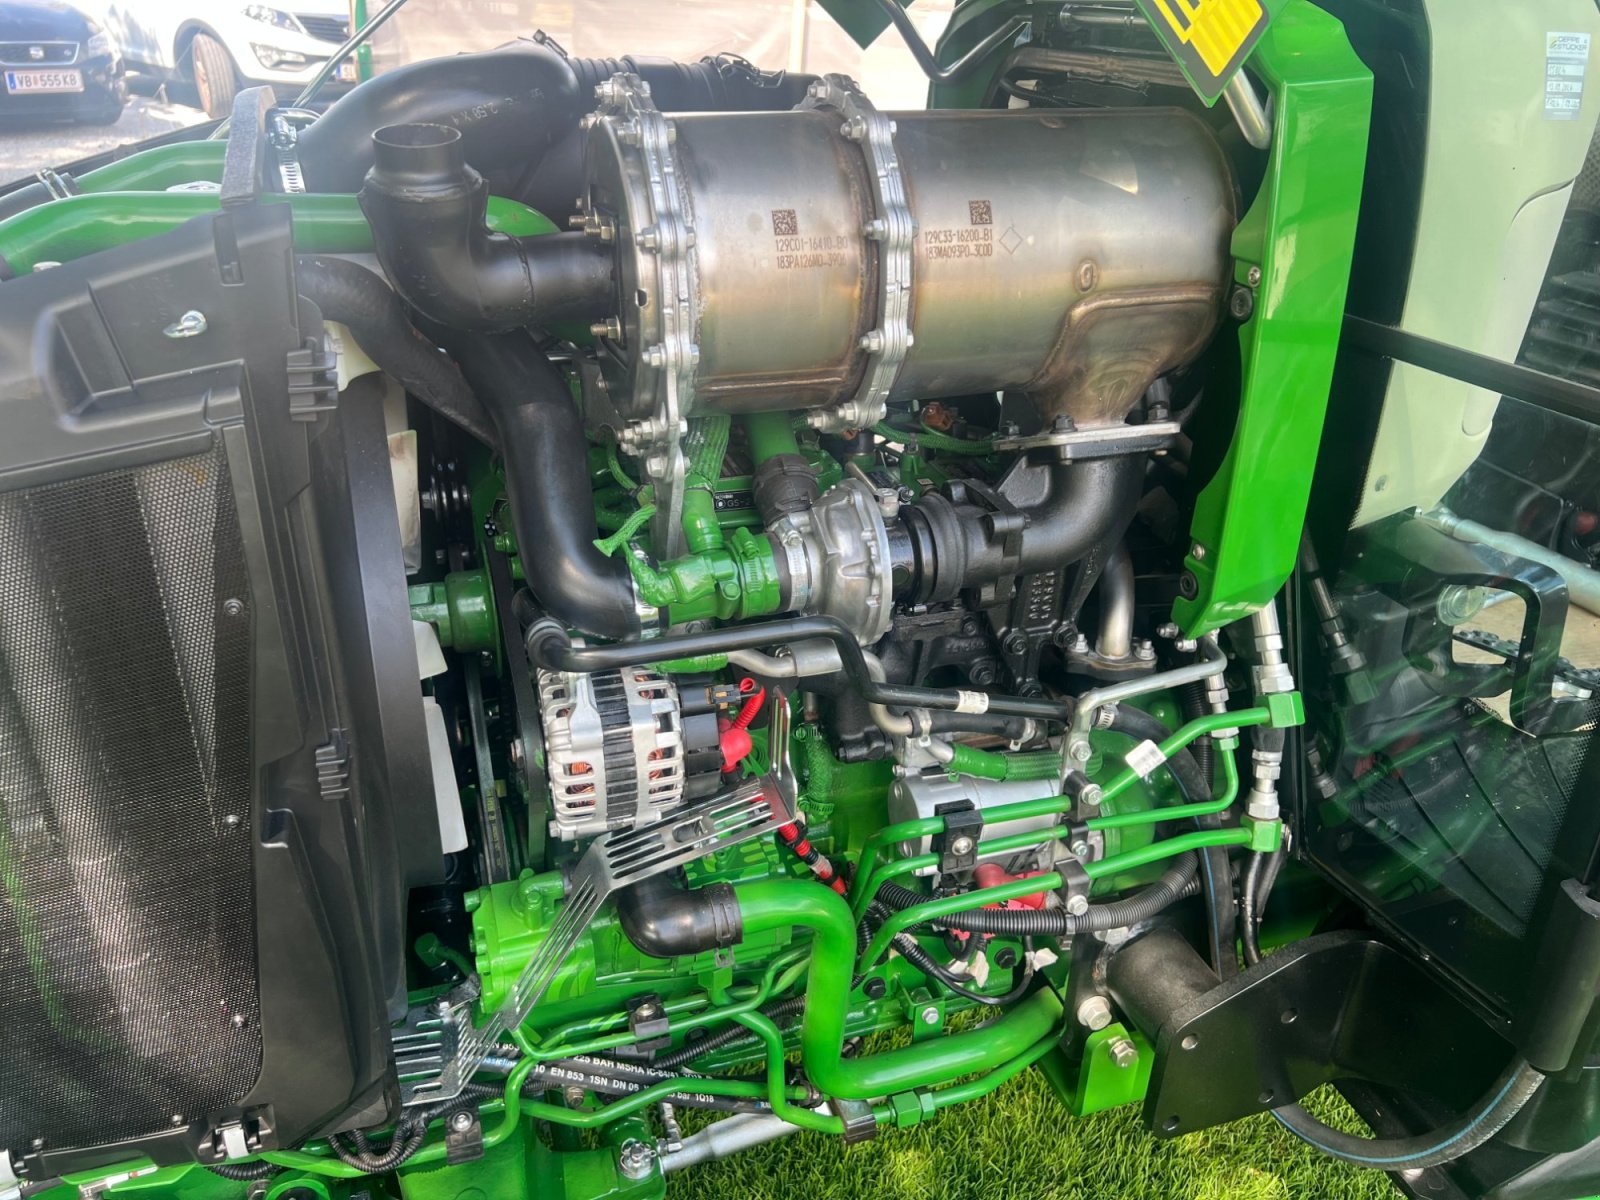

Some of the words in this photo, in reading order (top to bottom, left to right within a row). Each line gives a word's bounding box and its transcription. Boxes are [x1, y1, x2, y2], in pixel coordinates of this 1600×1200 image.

[593, 1058, 615, 1068] BAR
[616, 1063, 645, 1074] MSHA
[551, 1067, 565, 1078] EN
[566, 1071, 584, 1082] 853
[589, 1075, 608, 1086] 1SN
[612, 1080, 627, 1090] DN
[677, 1091, 690, 1100] bar
